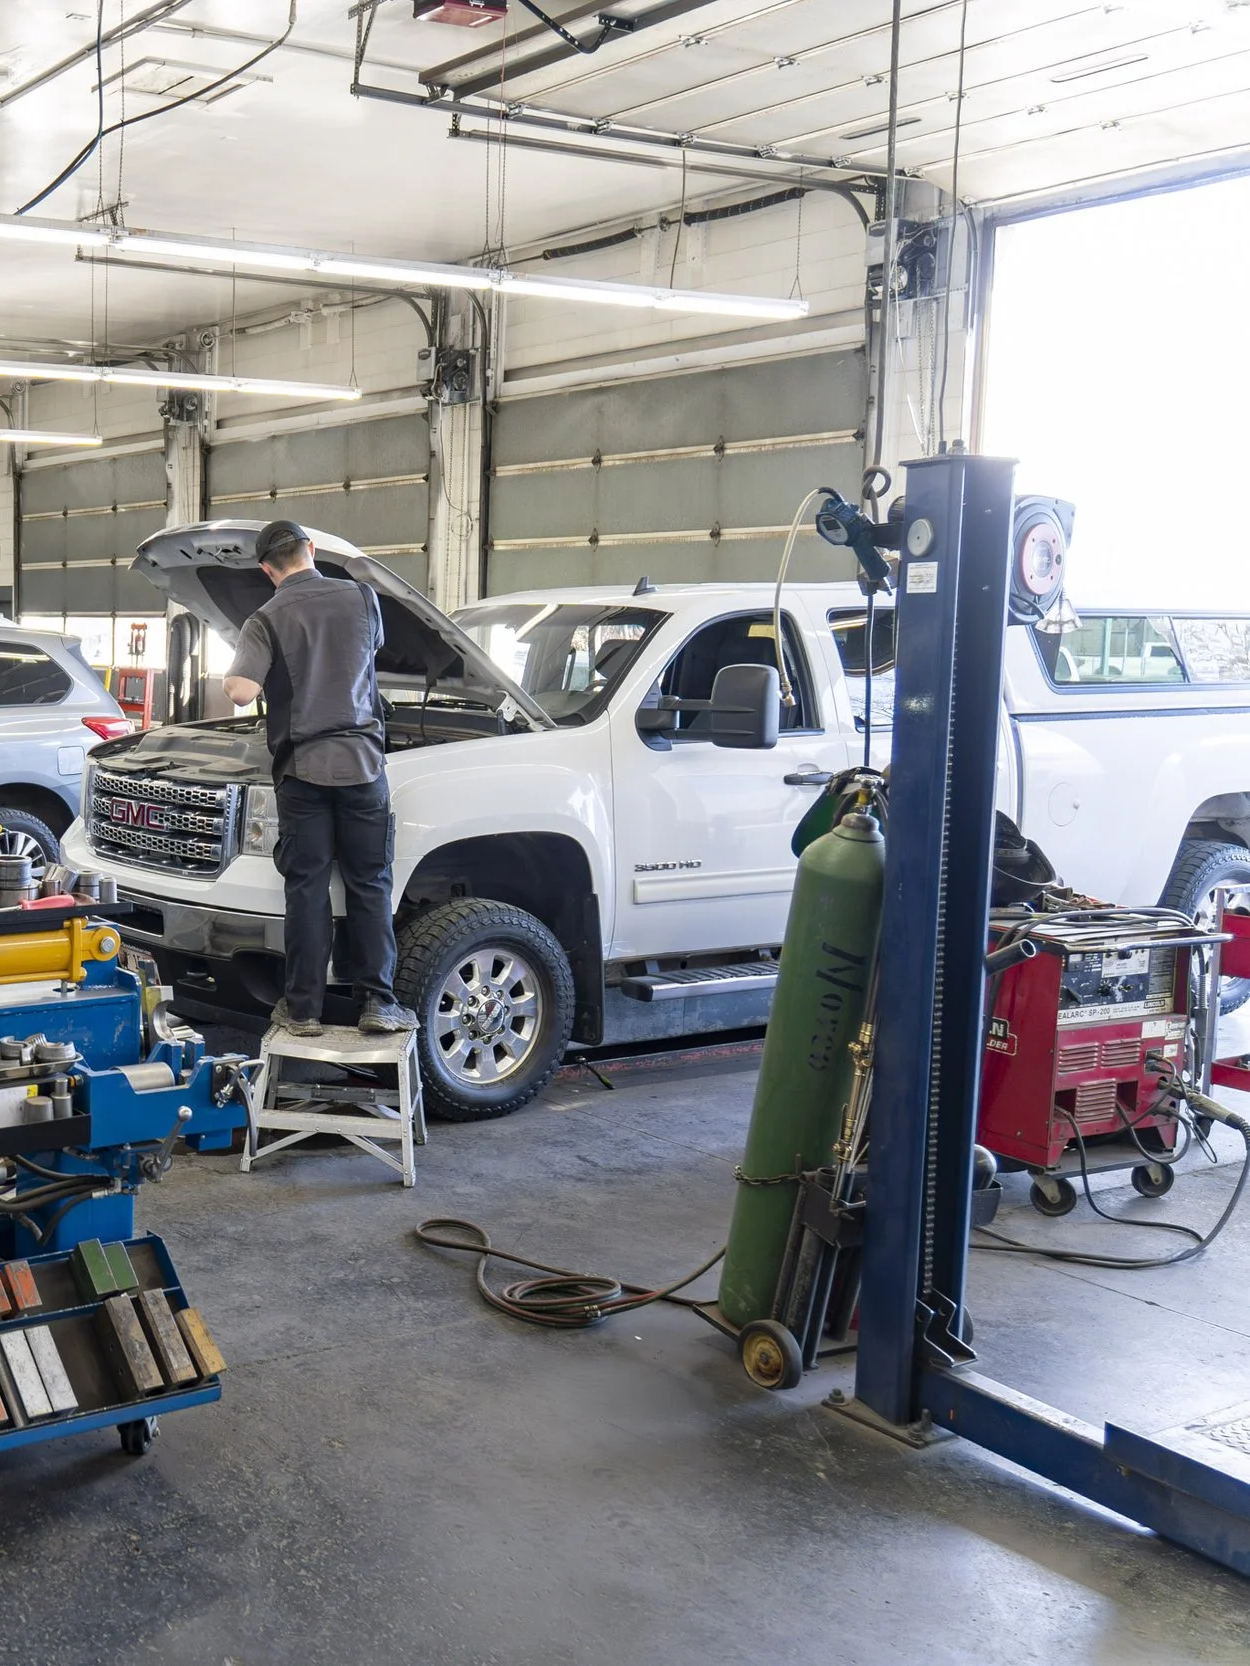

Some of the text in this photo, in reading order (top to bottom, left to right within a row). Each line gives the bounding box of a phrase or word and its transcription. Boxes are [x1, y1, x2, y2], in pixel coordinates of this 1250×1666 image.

[110, 797, 168, 831] GMC
[679, 860, 702, 869] HD
[1058, 1009, 1085, 1020] EALARC
[1088, 1006, 1111, 1018] SP-200
